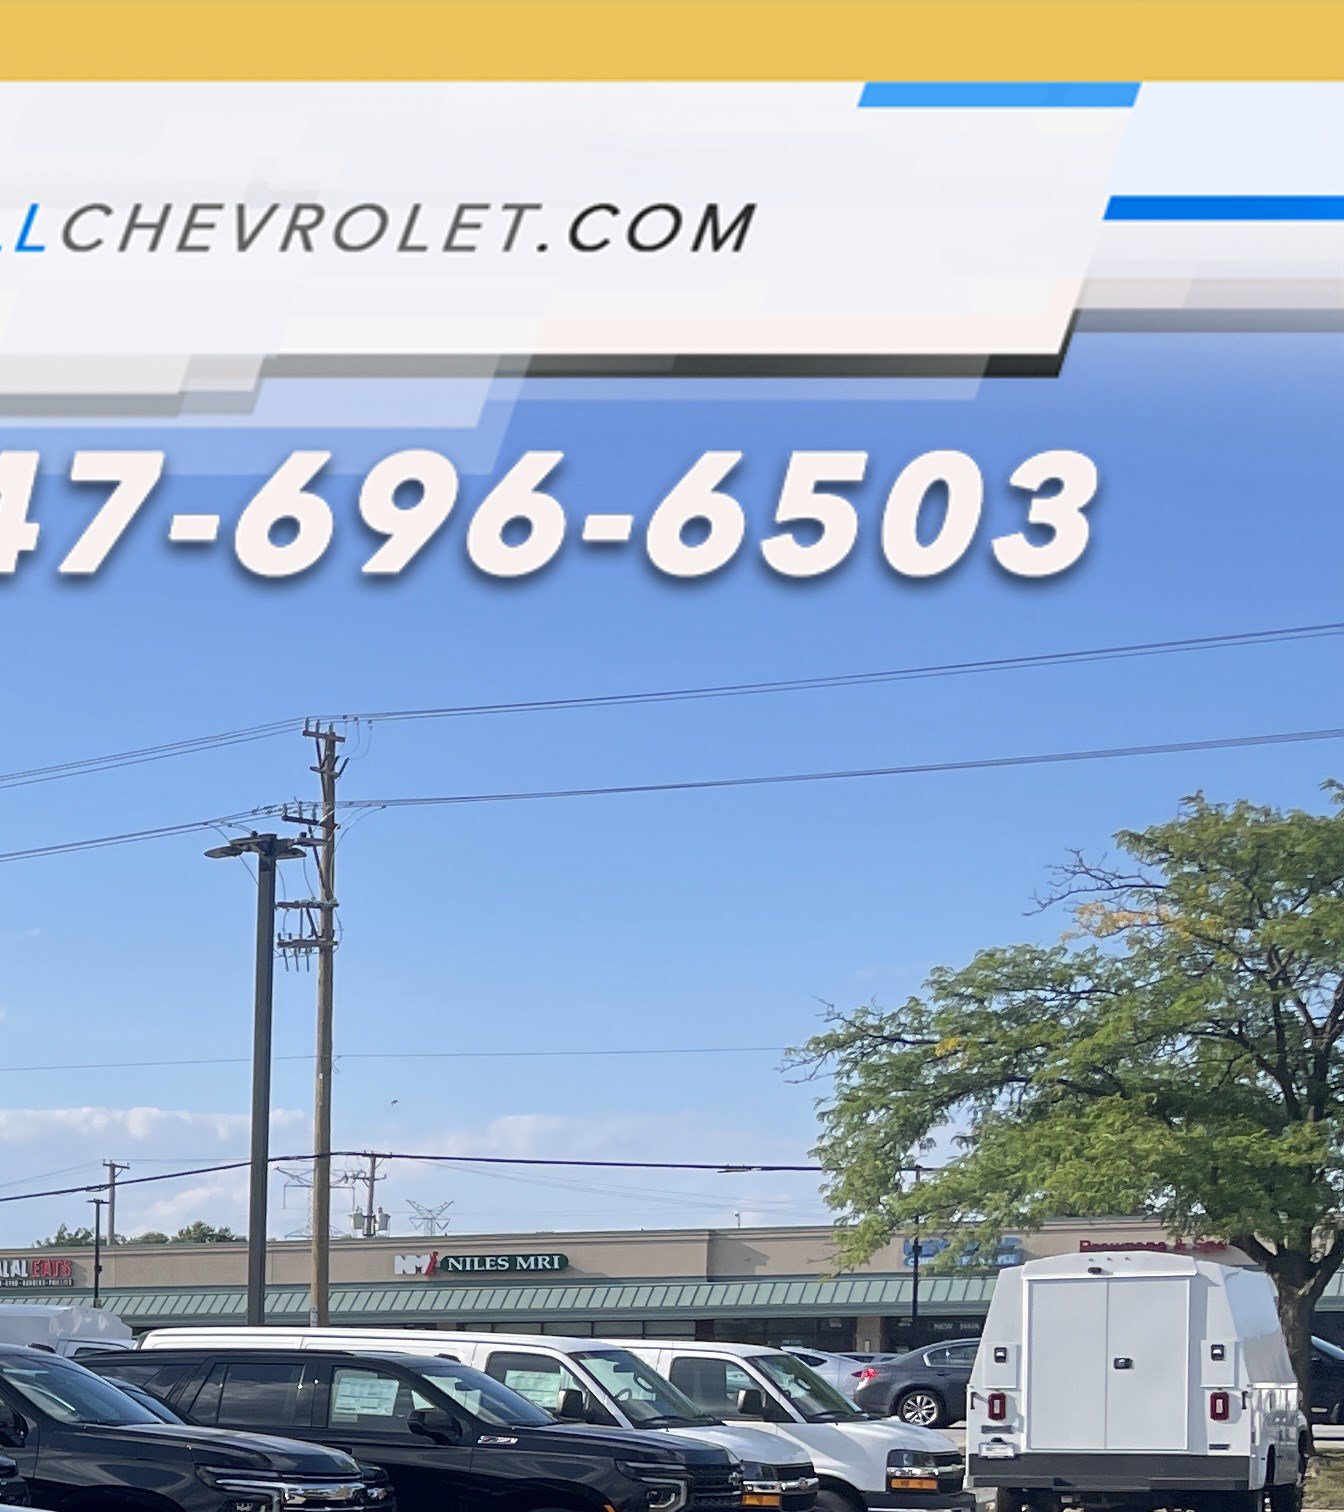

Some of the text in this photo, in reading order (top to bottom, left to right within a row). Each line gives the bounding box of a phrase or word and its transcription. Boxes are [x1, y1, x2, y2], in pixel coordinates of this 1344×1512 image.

[31, 1258, 73, 1278] EATS
[447, 1255, 561, 1271] NILES MRI
